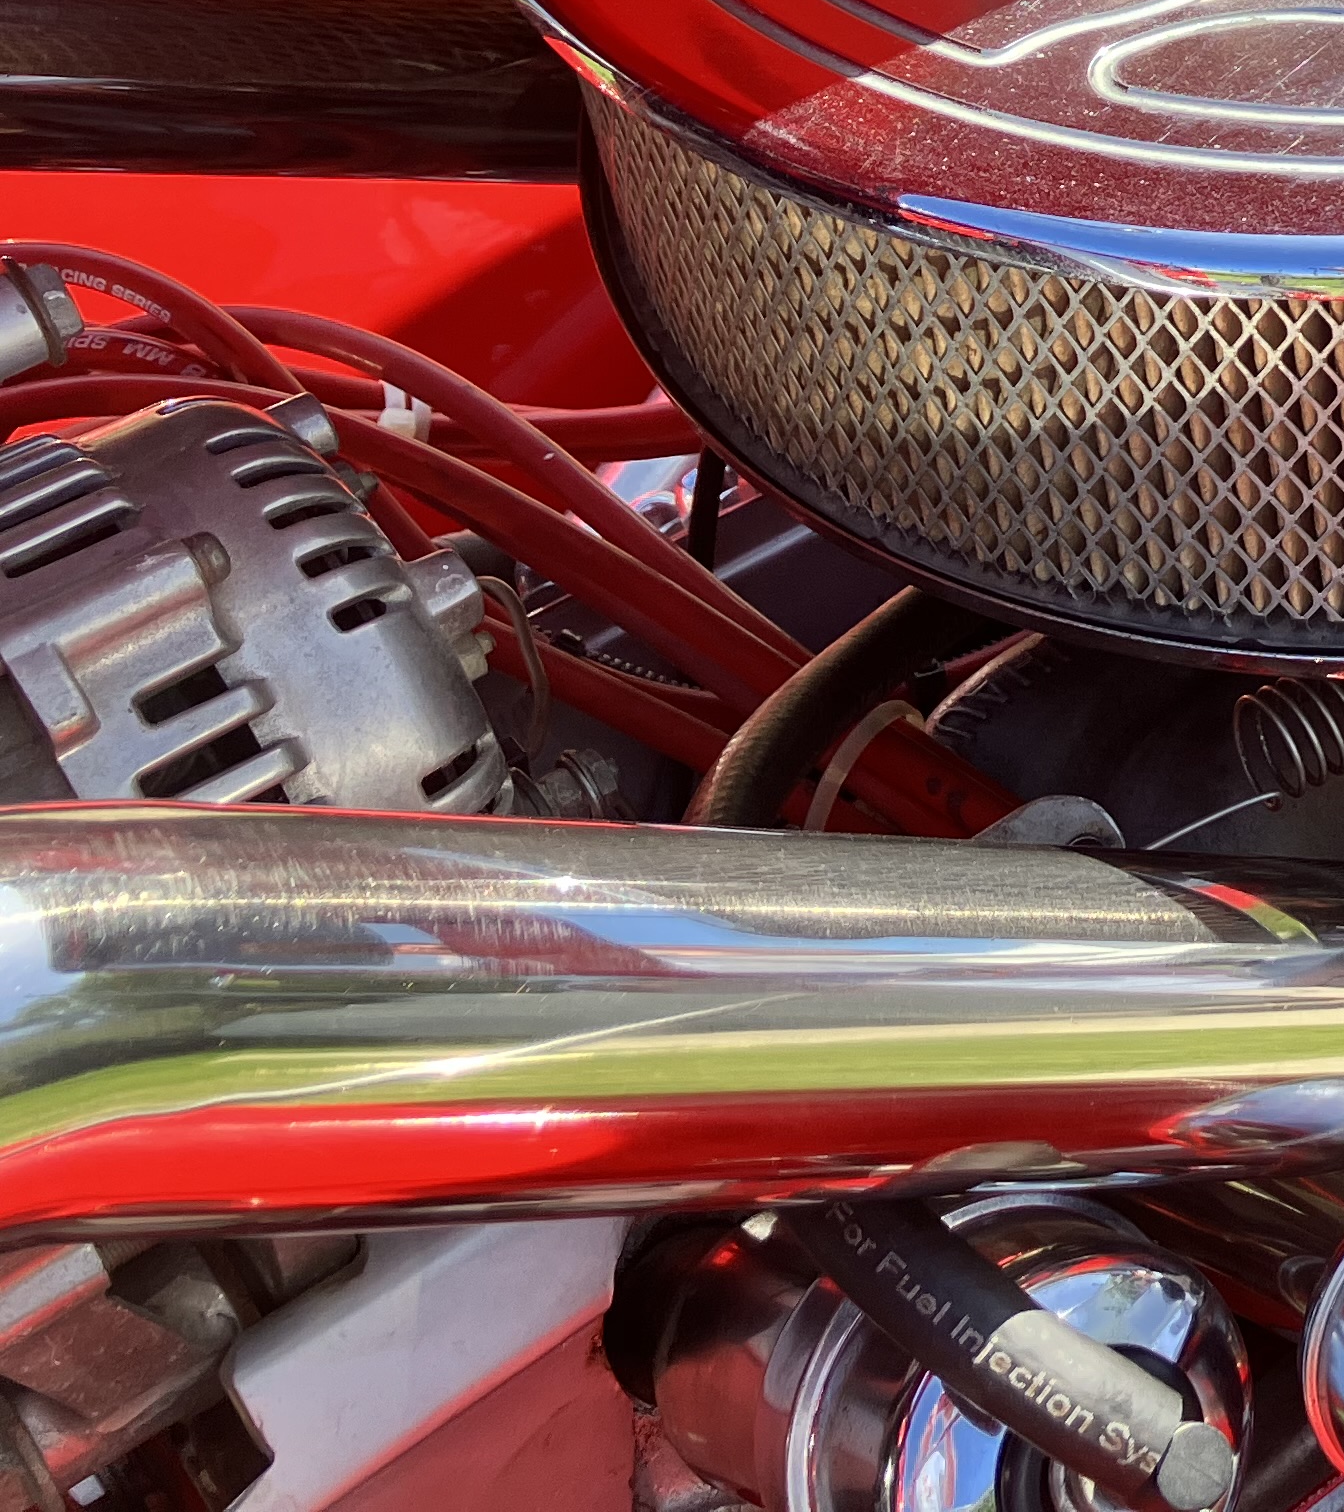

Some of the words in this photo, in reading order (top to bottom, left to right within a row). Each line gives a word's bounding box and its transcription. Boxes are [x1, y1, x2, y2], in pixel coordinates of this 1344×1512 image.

[111, 284, 172, 324] SERIES
[122, 340, 176, 366] MM
[826, 1200, 877, 1255] For
[875, 1250, 952, 1325] Fuel
[950, 1314, 1095, 1434] Injection
